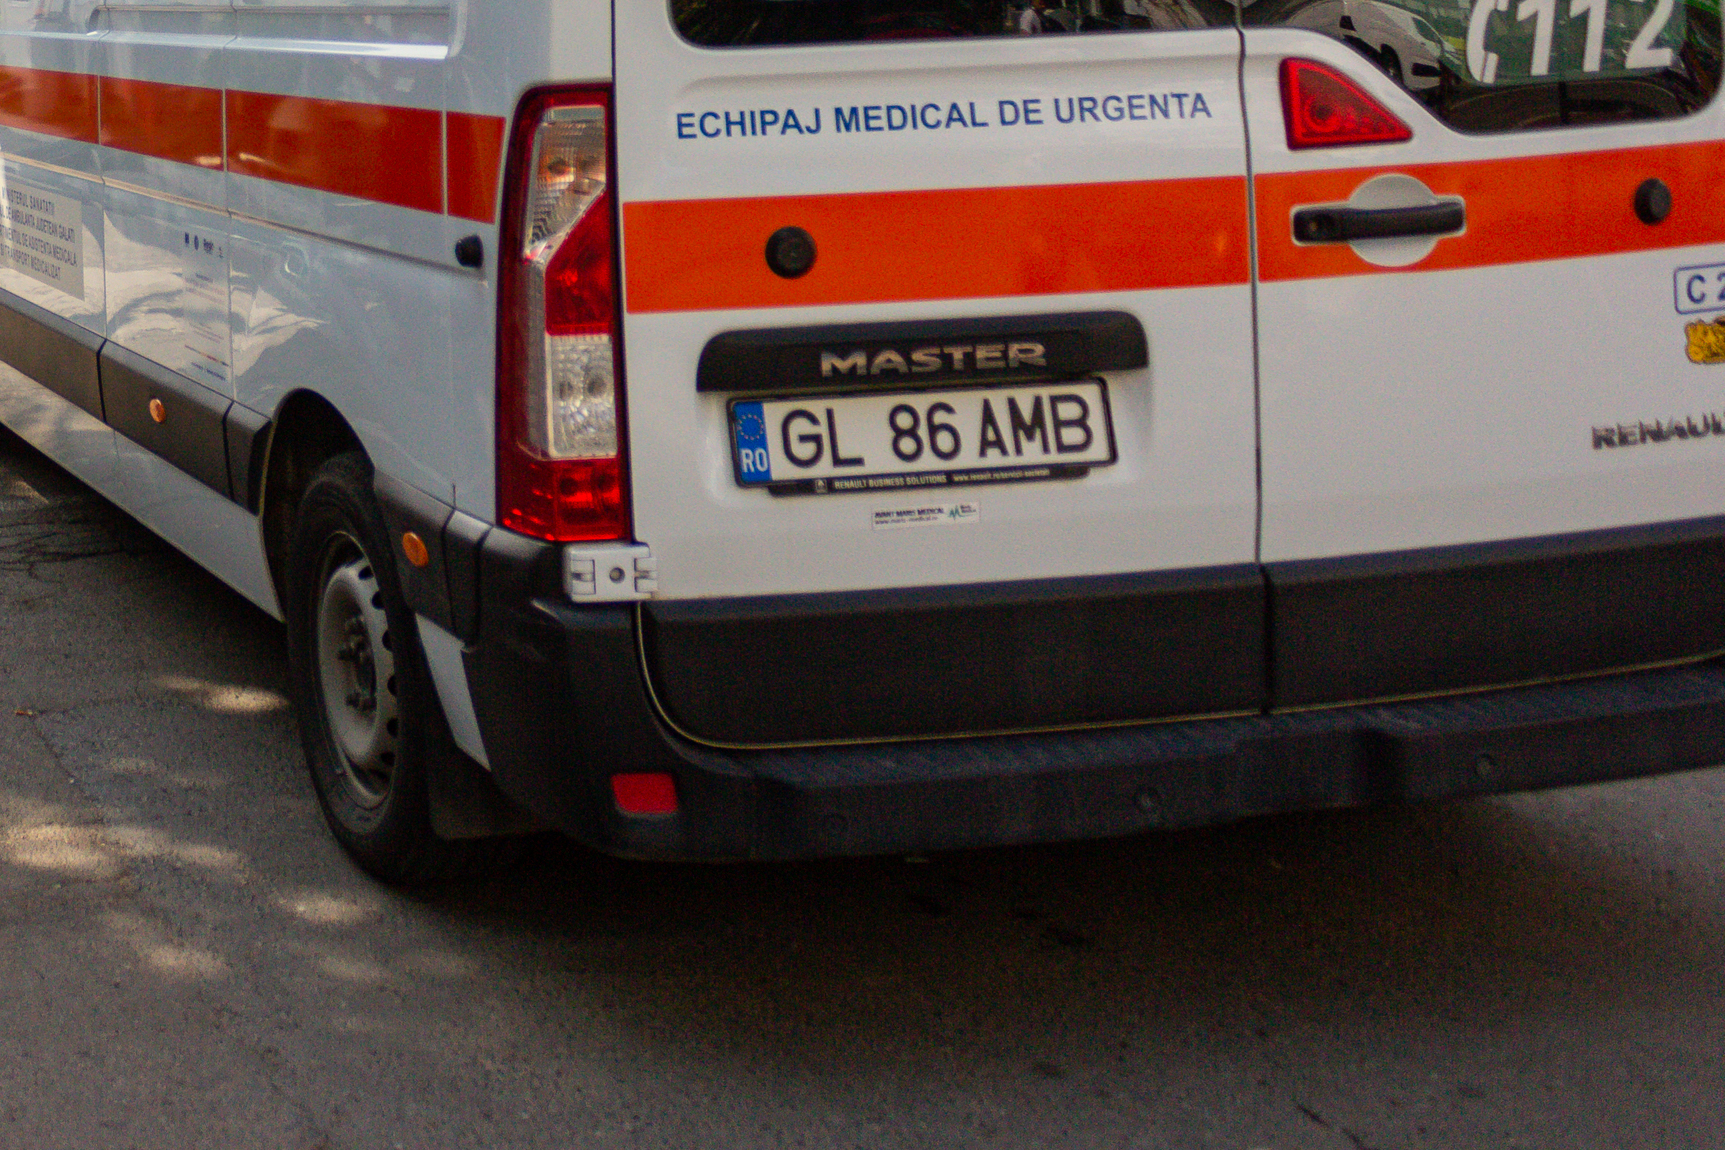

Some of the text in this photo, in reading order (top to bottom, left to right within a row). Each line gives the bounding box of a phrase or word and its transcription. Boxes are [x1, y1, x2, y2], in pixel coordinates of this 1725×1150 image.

[675, 92, 1213, 140] ECHIPAJ MEDICAL DE URGENTA
[820, 342, 1047, 378] MASTER
[781, 394, 1094, 469] GL 86 AMB
[1591, 412, 1725, 450] RENAUL
[741, 449, 768, 473] RO
[834, 478, 867, 490] RENAULT
[868, 476, 905, 488] BUSINESS
[906, 474, 947, 486] SOLUTIONS
